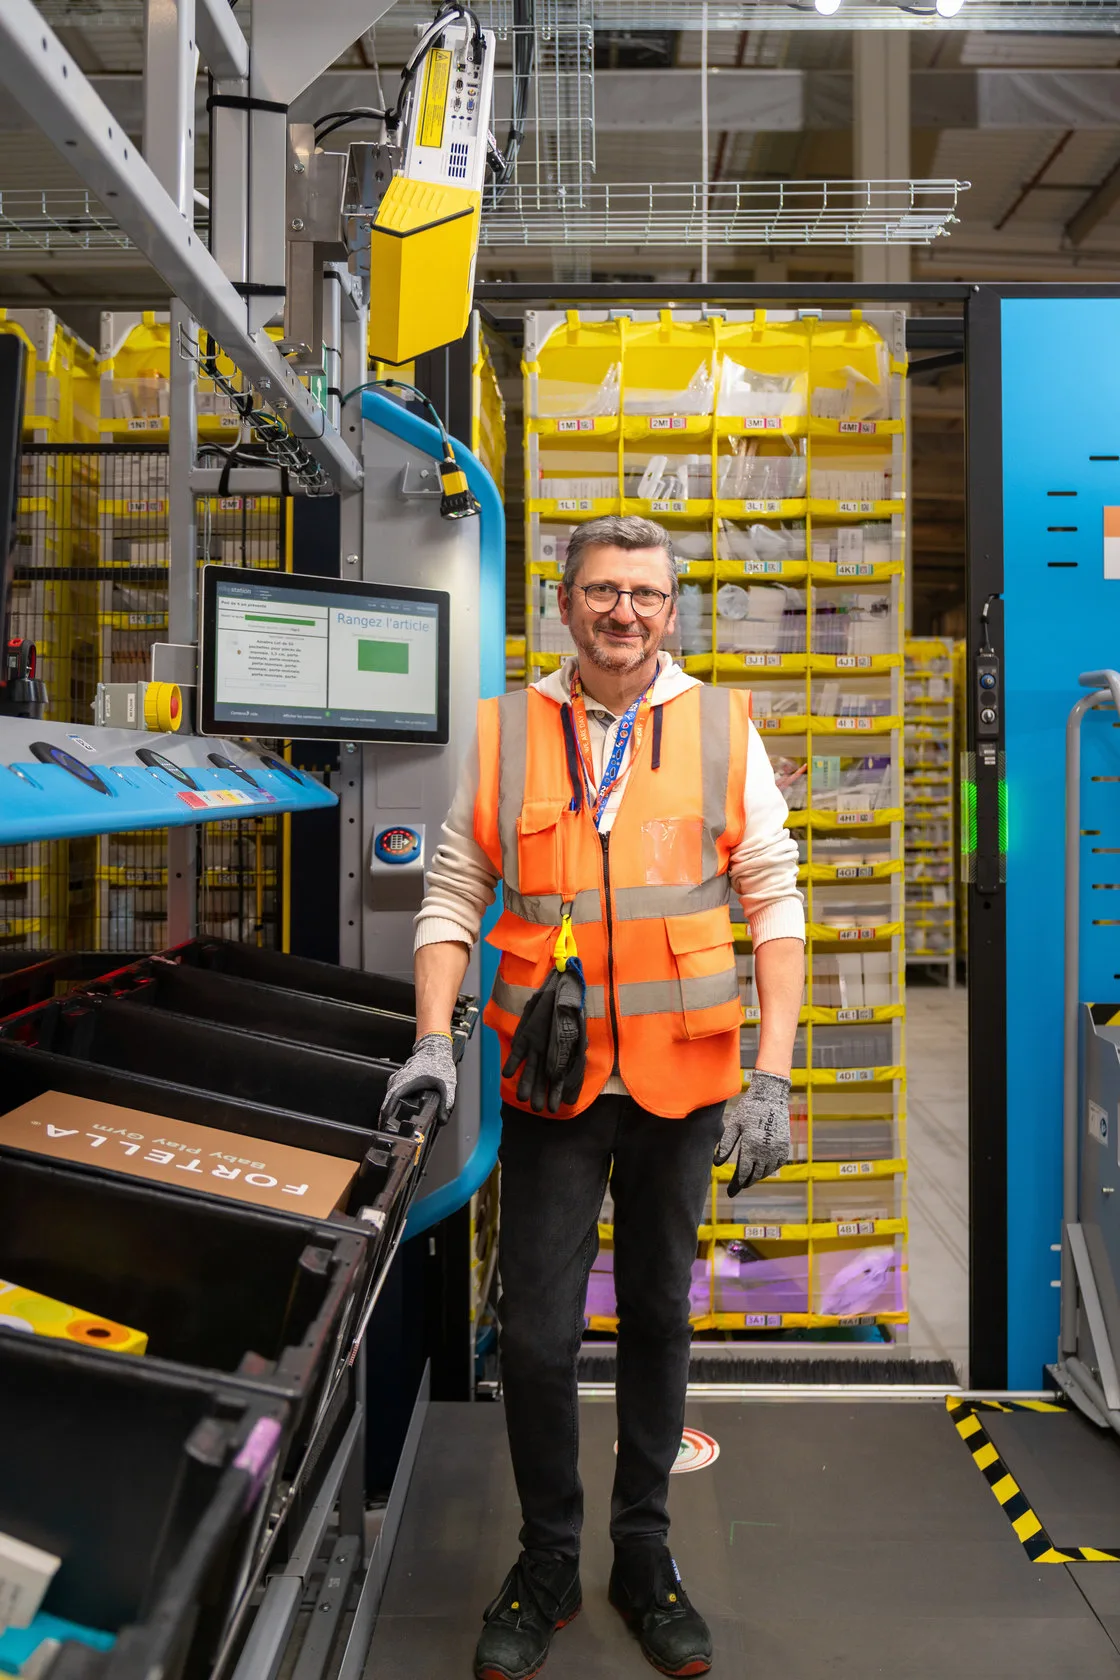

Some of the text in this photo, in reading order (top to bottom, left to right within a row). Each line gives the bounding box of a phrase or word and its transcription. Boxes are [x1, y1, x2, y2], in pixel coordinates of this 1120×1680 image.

[337, 612, 429, 632] Rangez l'article
[578, 716, 586, 728] DAY
[762, 1112, 775, 1145] HyFlex
[44, 1123, 310, 1196] FORTELLA
[92, 1122, 266, 1170] Baby Play Gym
